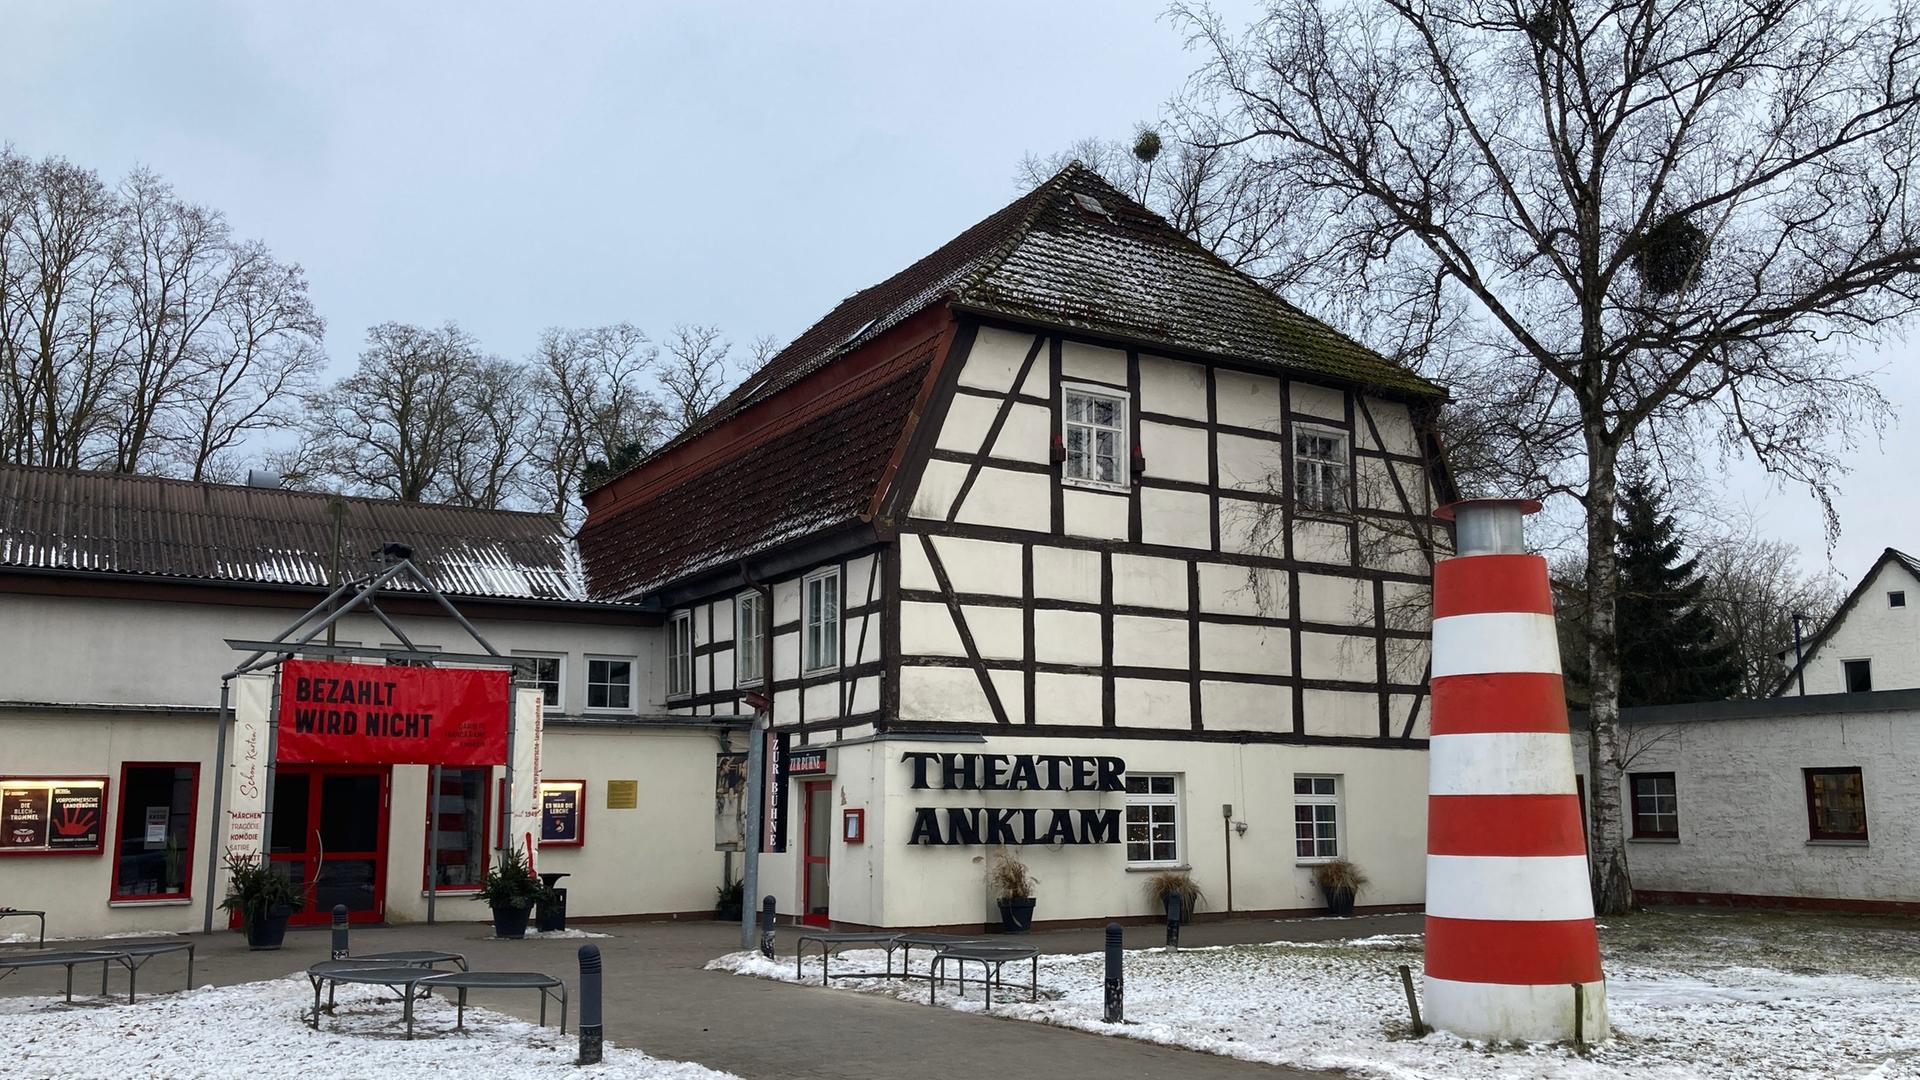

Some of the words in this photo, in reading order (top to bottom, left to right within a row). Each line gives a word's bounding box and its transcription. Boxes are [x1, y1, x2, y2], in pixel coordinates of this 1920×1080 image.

[296, 677, 397, 706] BEZAHLT
[295, 708, 358, 735] WIRD
[365, 711, 433, 738] NICHT
[245, 723, 258, 761] Karten?
[772, 739, 780, 775] ZUR
[789, 758, 802, 771] ZUR
[801, 754, 821, 770] BÜHNE
[900, 752, 1127, 792] THEATER
[240, 764, 258, 799] Schon
[231, 822, 260, 830] TRAGÖDIE
[232, 811, 262, 819] MÄRCHEN
[769, 781, 779, 846] BÜHNE
[907, 807, 1123, 845] ANKLAM
[230, 833, 258, 841] KOMÖDIE
